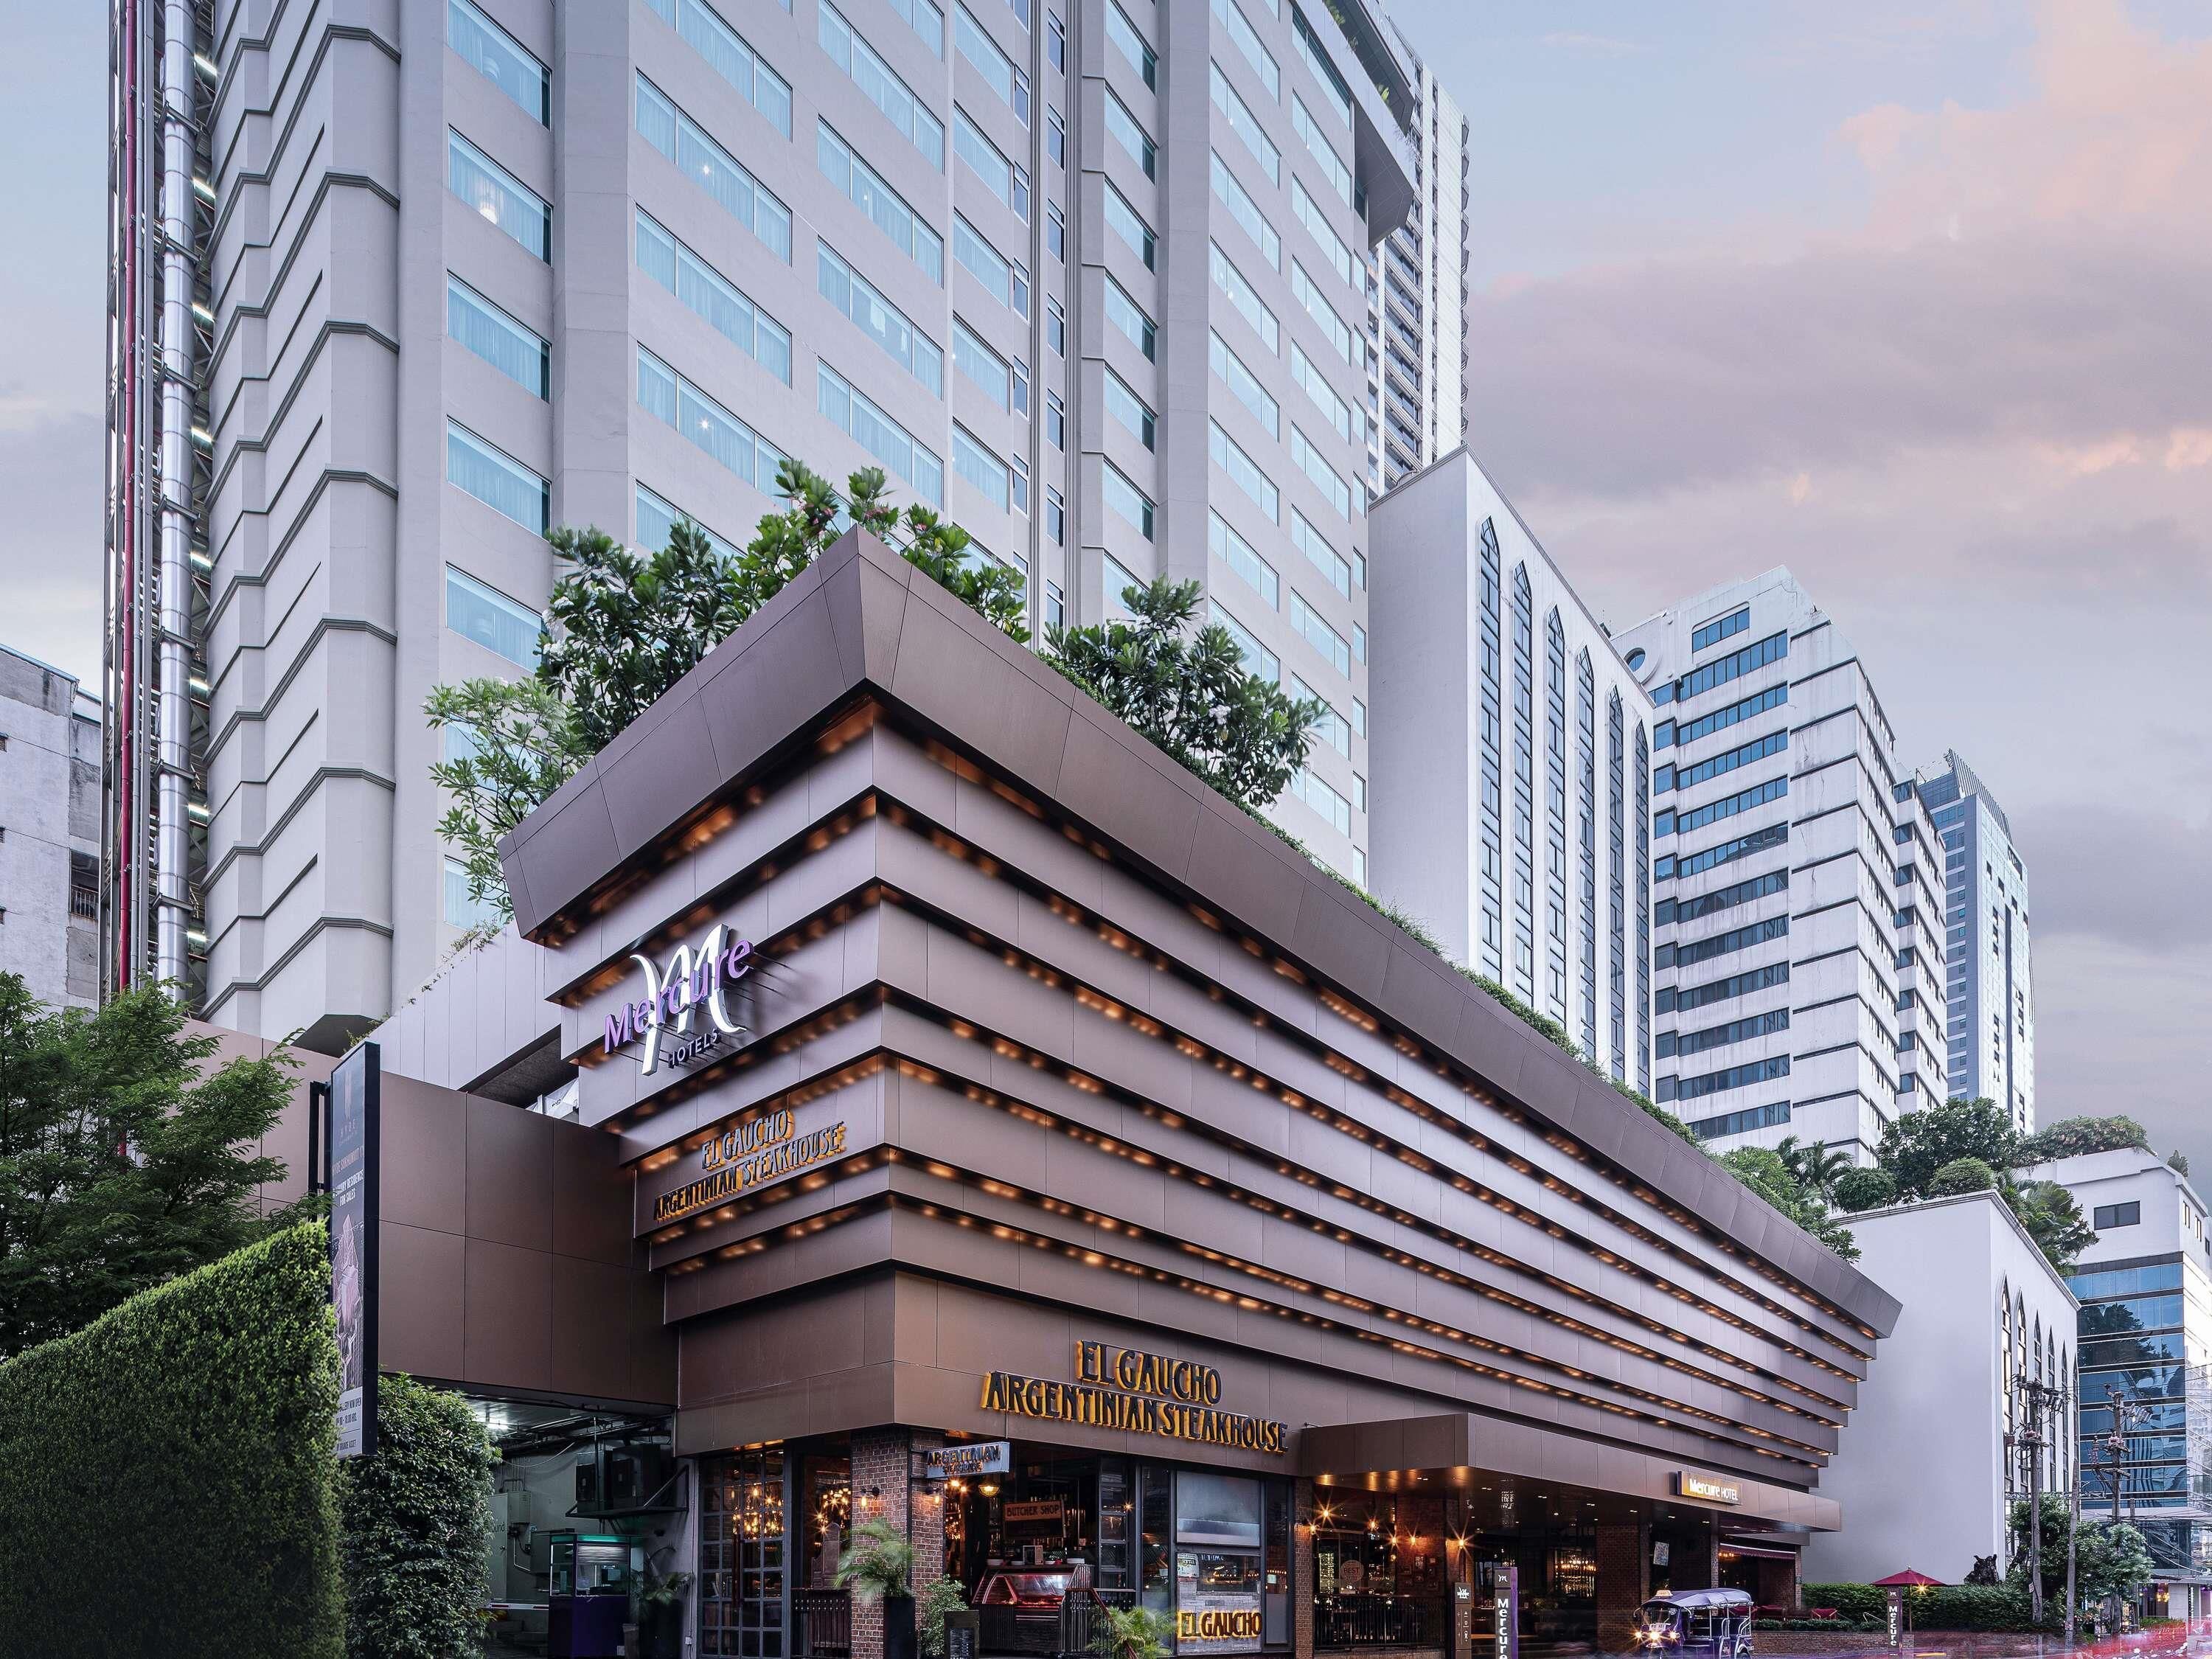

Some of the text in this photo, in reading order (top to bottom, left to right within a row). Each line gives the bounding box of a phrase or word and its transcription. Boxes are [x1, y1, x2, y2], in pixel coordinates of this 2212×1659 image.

[605, 939, 754, 1054] Mercure
[668, 1028, 722, 1068] HOTELS
[701, 1109, 795, 1171] EL GAUCHO
[653, 1121, 846, 1222] ARGENTINIAN STEAKHOUSE
[346, 1187, 355, 1203] SALES
[1077, 1339, 1222, 1405] EL GAUCHO
[981, 1371, 1288, 1454] ARGENTINIAN STEAKHOUSE
[928, 1445, 1001, 1467] ARGENTINIAN
[1688, 1478, 1739, 1500] Mercure HOTEL
[1006, 1504, 1060, 1517] BUTCHER SHOP
[1178, 1610, 1263, 1638] EL GAUCHO
[1498, 1598, 1509, 1659] Mercure
[1889, 1605, 1898, 1646] Mercure
